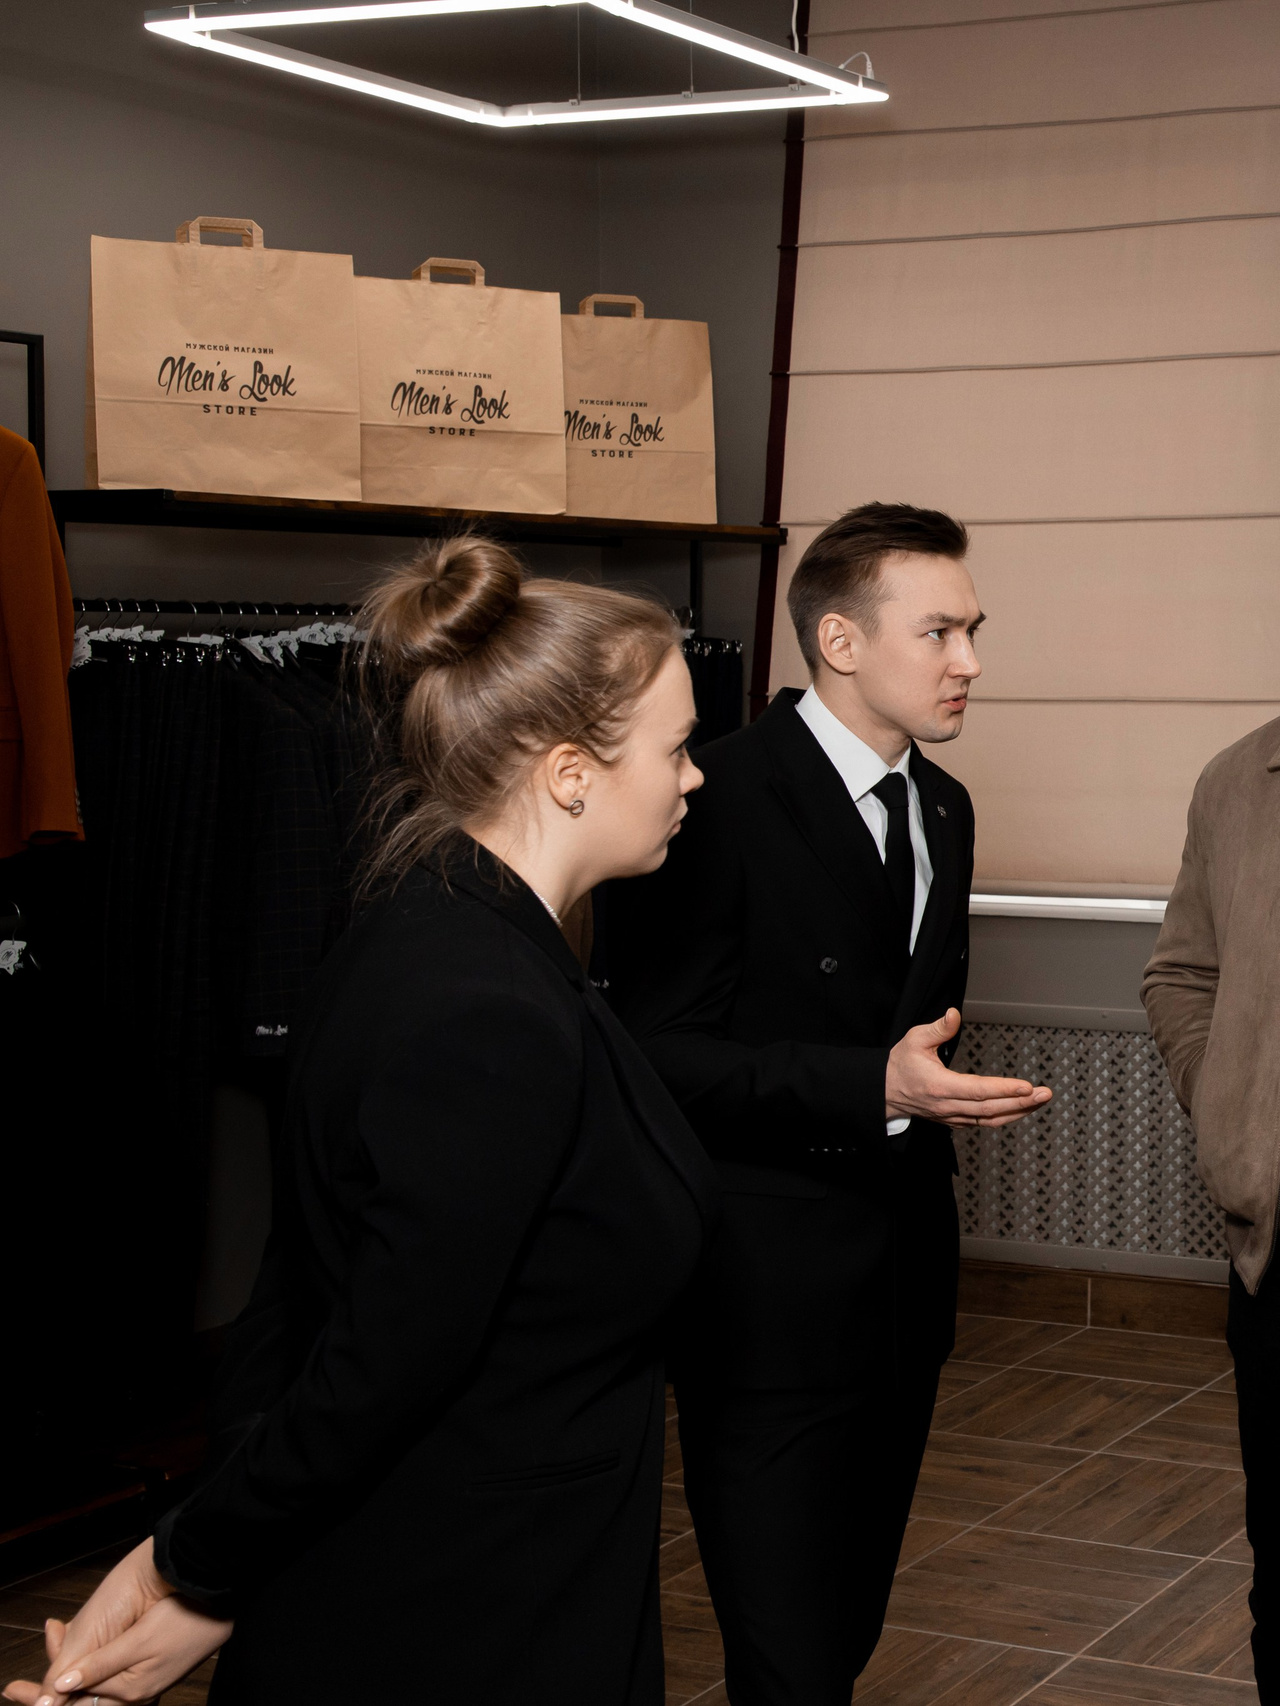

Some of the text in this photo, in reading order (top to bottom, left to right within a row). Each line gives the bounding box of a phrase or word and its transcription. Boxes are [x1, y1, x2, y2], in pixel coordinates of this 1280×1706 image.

[186, 343, 274, 355] МУЖСКОЙ МАГАЗИН
[158, 355, 297, 402] Men's Look
[416, 369, 492, 380] МУЖСКОЙ МАГАЗИН
[391, 381, 511, 424] Men's Look
[203, 404, 257, 416] STORE
[428, 426, 476, 437] STORE
[564, 410, 665, 447] Men's Look
[591, 449, 633, 458] STORE
